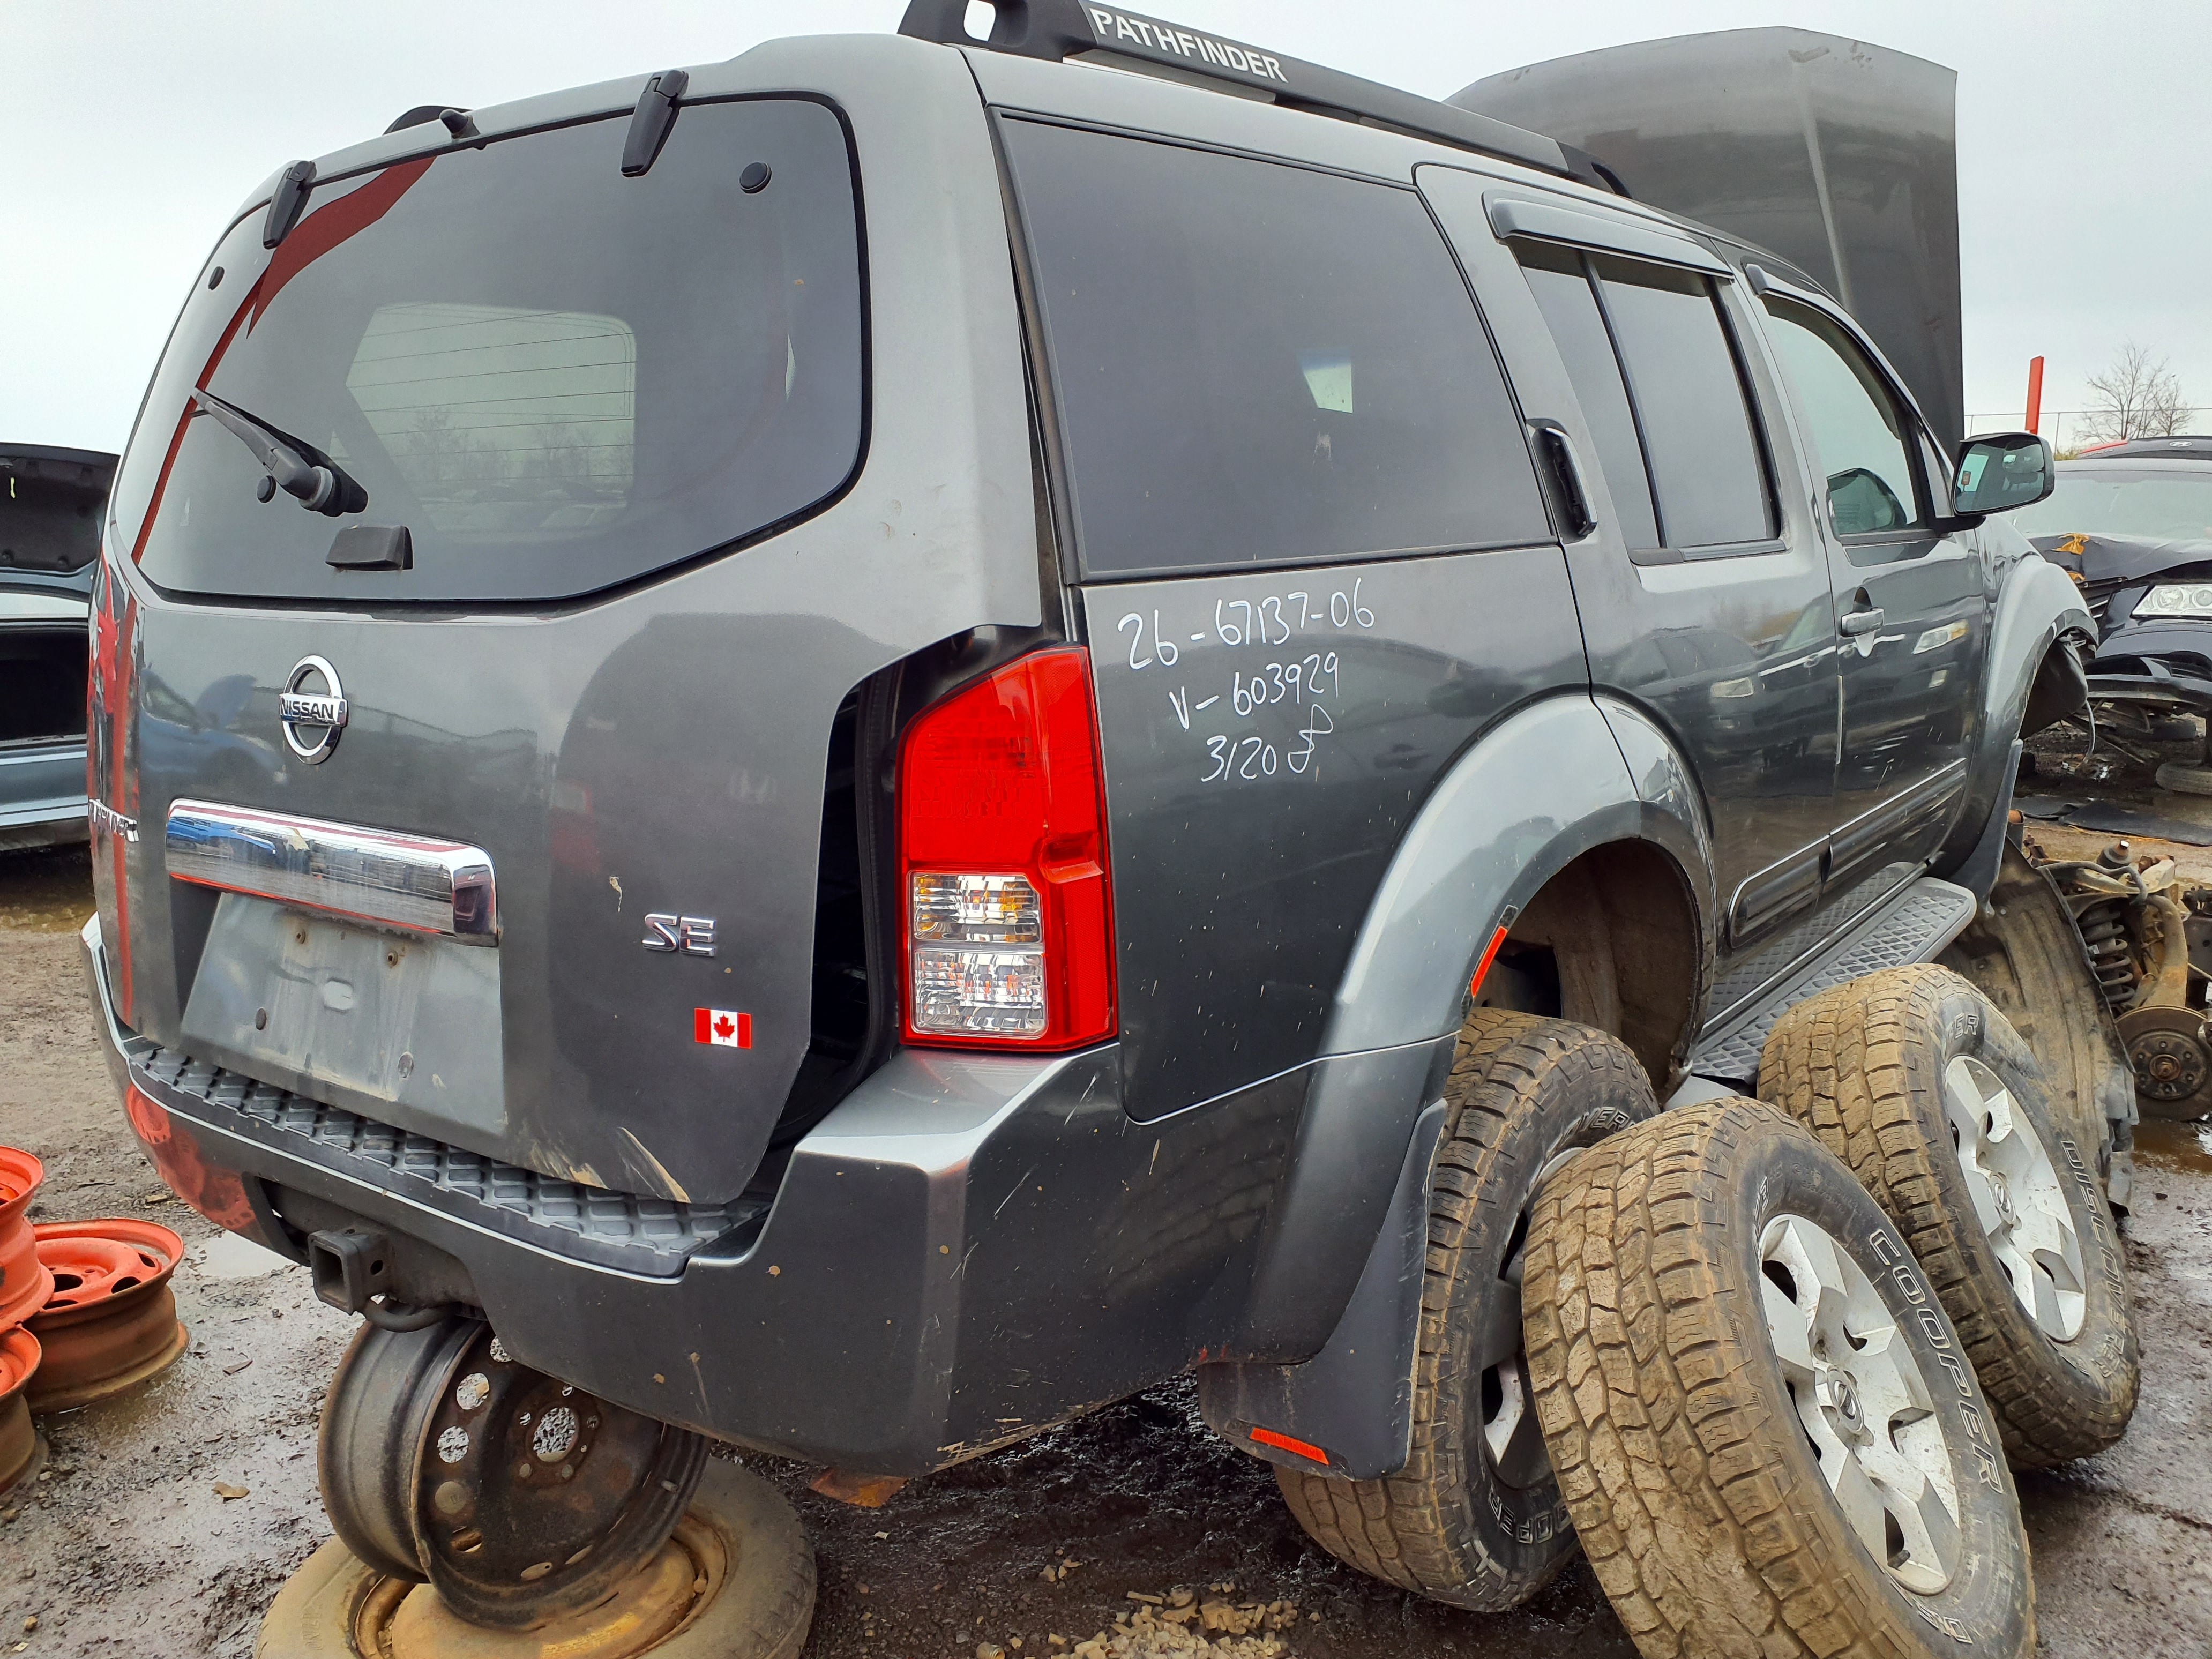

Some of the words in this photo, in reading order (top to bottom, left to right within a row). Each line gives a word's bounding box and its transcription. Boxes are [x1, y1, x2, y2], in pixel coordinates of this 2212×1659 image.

[1089, 8, 1289, 83] PATHFINDER
[280, 697, 334, 720] NISSAN
[642, 913, 716, 958] SE
[1869, 1229, 2004, 1494] COOPER
